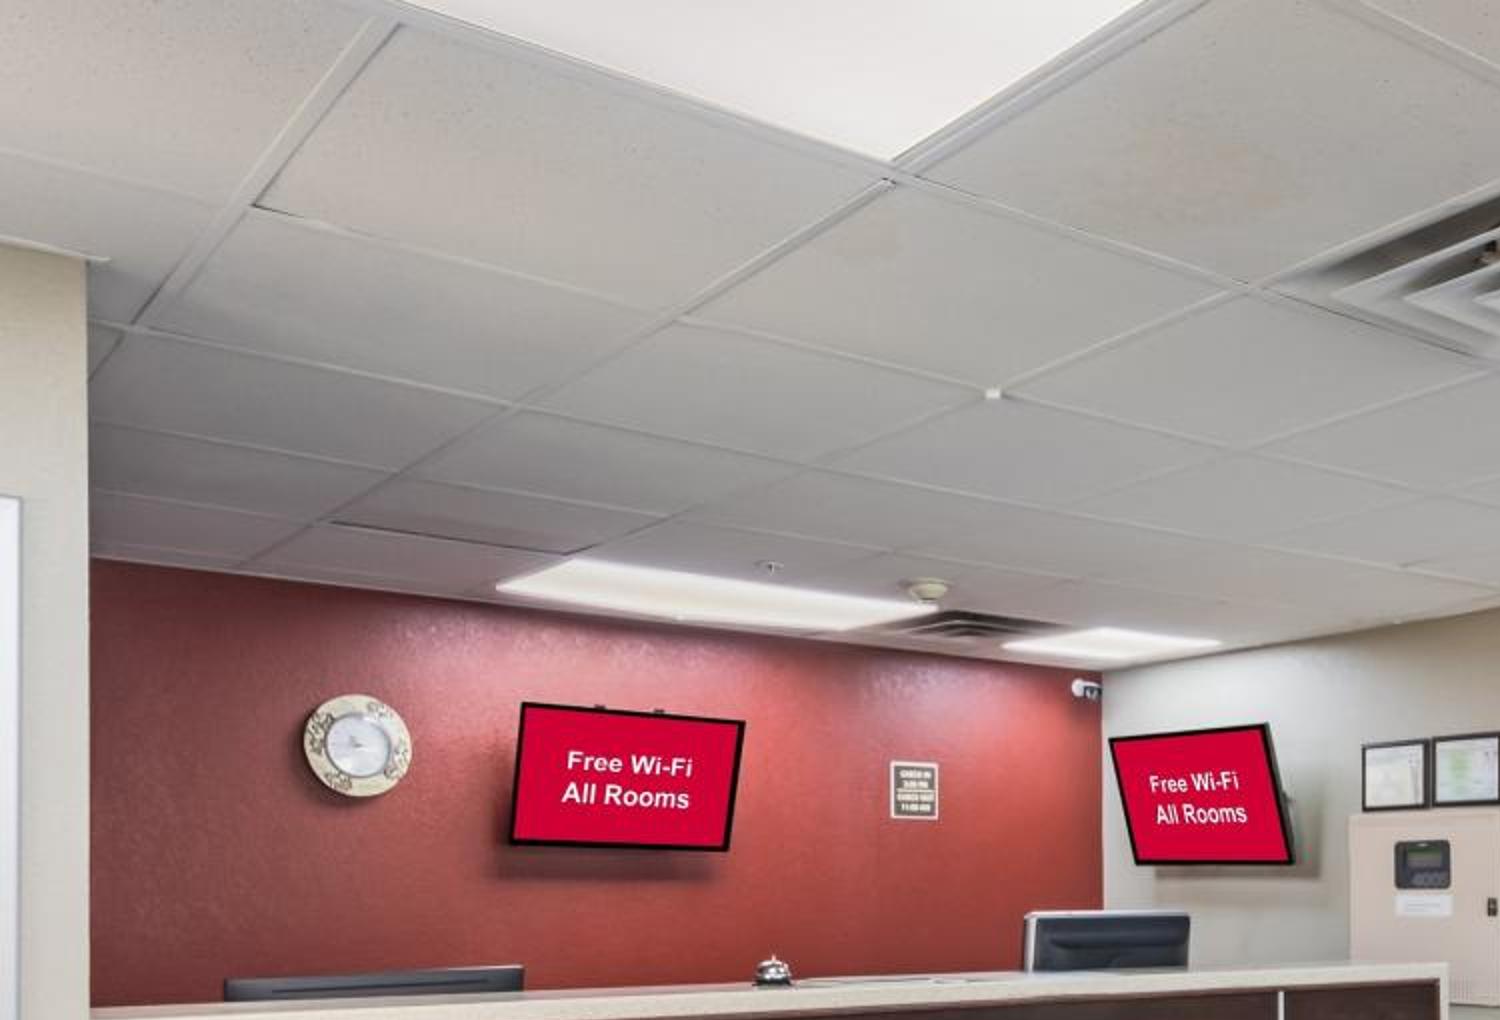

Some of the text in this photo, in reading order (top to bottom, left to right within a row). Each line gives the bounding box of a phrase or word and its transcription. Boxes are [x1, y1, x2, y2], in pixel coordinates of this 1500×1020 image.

[567, 750, 693, 778] Free Wi-Fi
[1149, 770, 1239, 793] Free Wi-Fi
[561, 781, 690, 809] All Rooms
[1157, 803, 1248, 825] All Rooms
